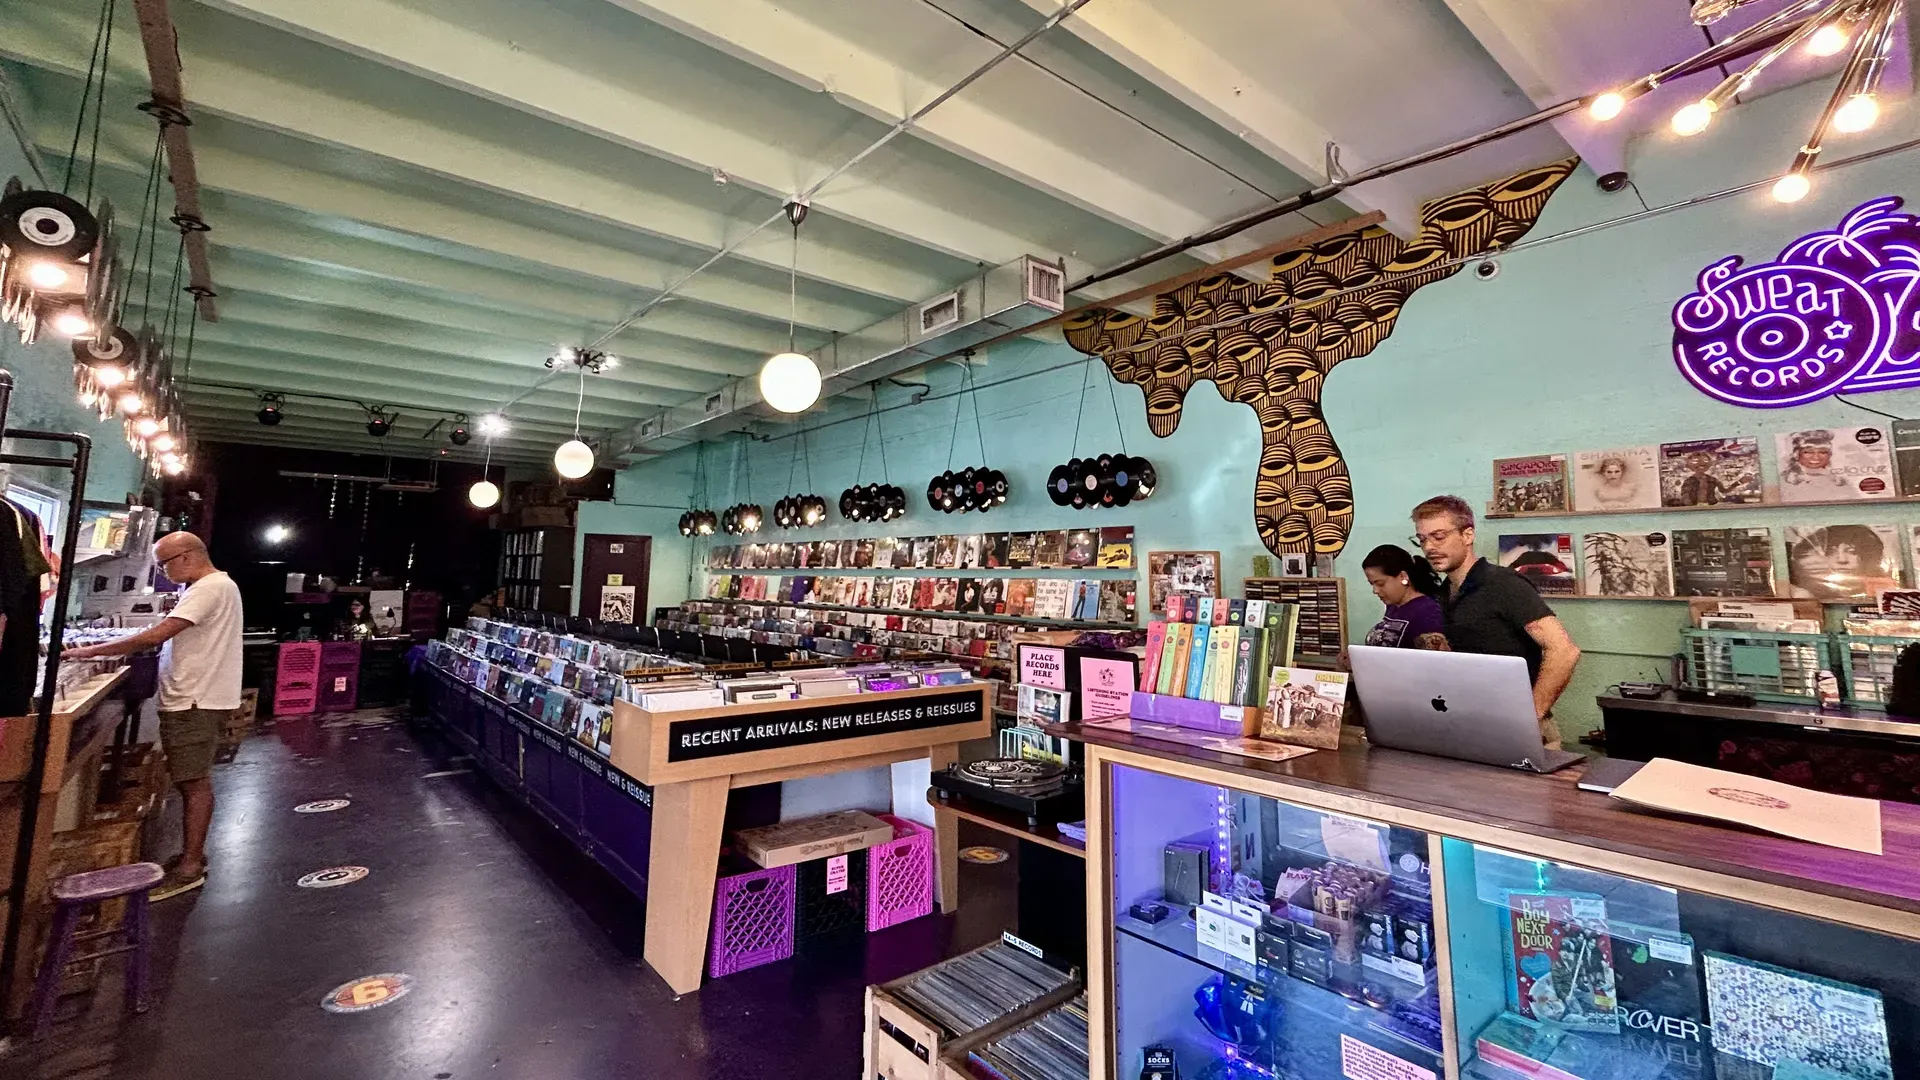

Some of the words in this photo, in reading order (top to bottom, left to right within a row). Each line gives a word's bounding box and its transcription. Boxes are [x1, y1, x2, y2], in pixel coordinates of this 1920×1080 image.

[1697, 341, 1845, 387] RECORDS
[1580, 448, 1650, 460] SHAKIRA
[1500, 461, 1559, 472] SINGAPORE
[1030, 652, 1054, 662] PLACE
[1026, 661, 1060, 670] RECORDS
[1033, 669, 1052, 678] HERE
[681, 728, 742, 748] RECENT
[744, 720, 819, 740] ARRIVALS:
[822, 715, 852, 730] NEW
[855, 709, 912, 726] RELEASES
[914, 706, 924, 719] &
[926, 701, 976, 718] REISSUES
[568, 746, 578, 760] NEW
[584, 754, 602, 777] REISSUE
[606, 769, 620, 788] NEW
[621, 780, 626, 790] &
[626, 780, 651, 808] REISSUE
[1286, 872, 1310, 880] RAW
[1516, 918, 1546, 934] NEXT
[1018, 940, 1042, 957] RECORDS
[1520, 934, 1554, 950] DOOR
[352, 979, 391, 1005] 6
[1345, 1049, 1364, 1059] groove
[1387, 1066, 1396, 1074] kit
[1345, 1054, 1371, 1068] cartridge
[1373, 1064, 1400, 1080] headshell
